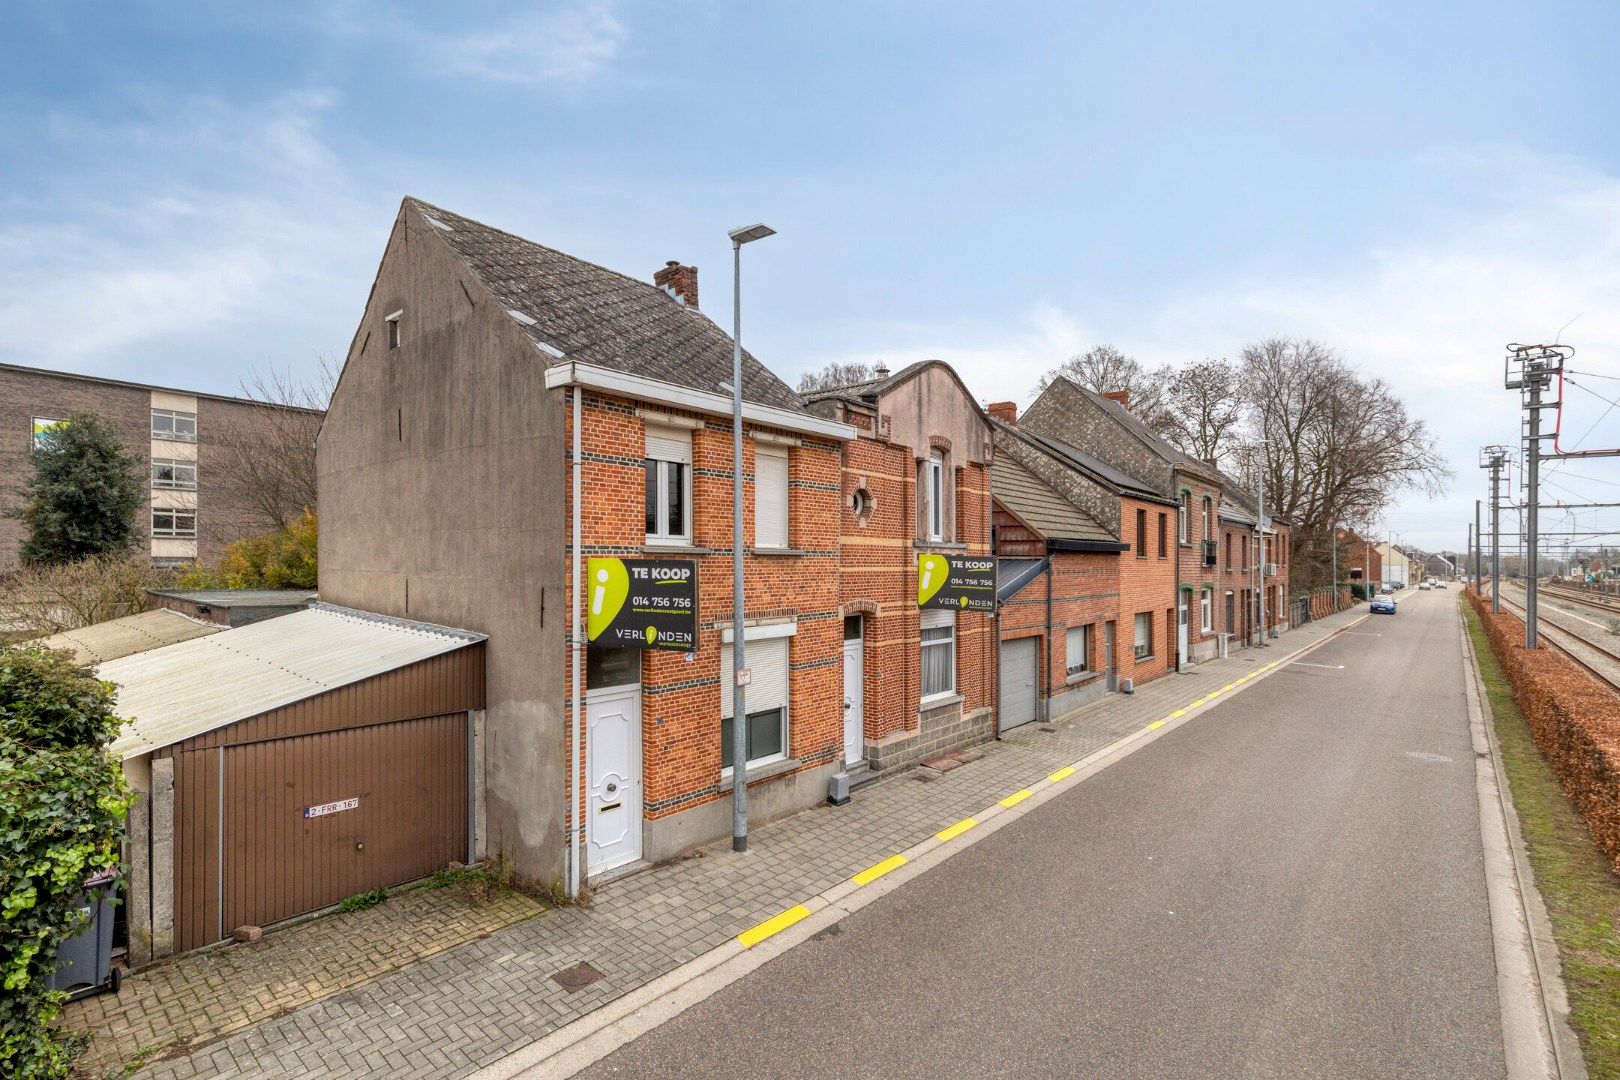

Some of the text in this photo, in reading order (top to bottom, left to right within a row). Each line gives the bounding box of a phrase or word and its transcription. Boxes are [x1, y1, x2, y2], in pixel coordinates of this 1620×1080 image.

[965, 561, 993, 569] KOOP
[632, 568, 691, 580] TE KOOP
[965, 578, 978, 586] 756
[980, 579, 993, 587] 756
[632, 596, 691, 608] 014 756 756
